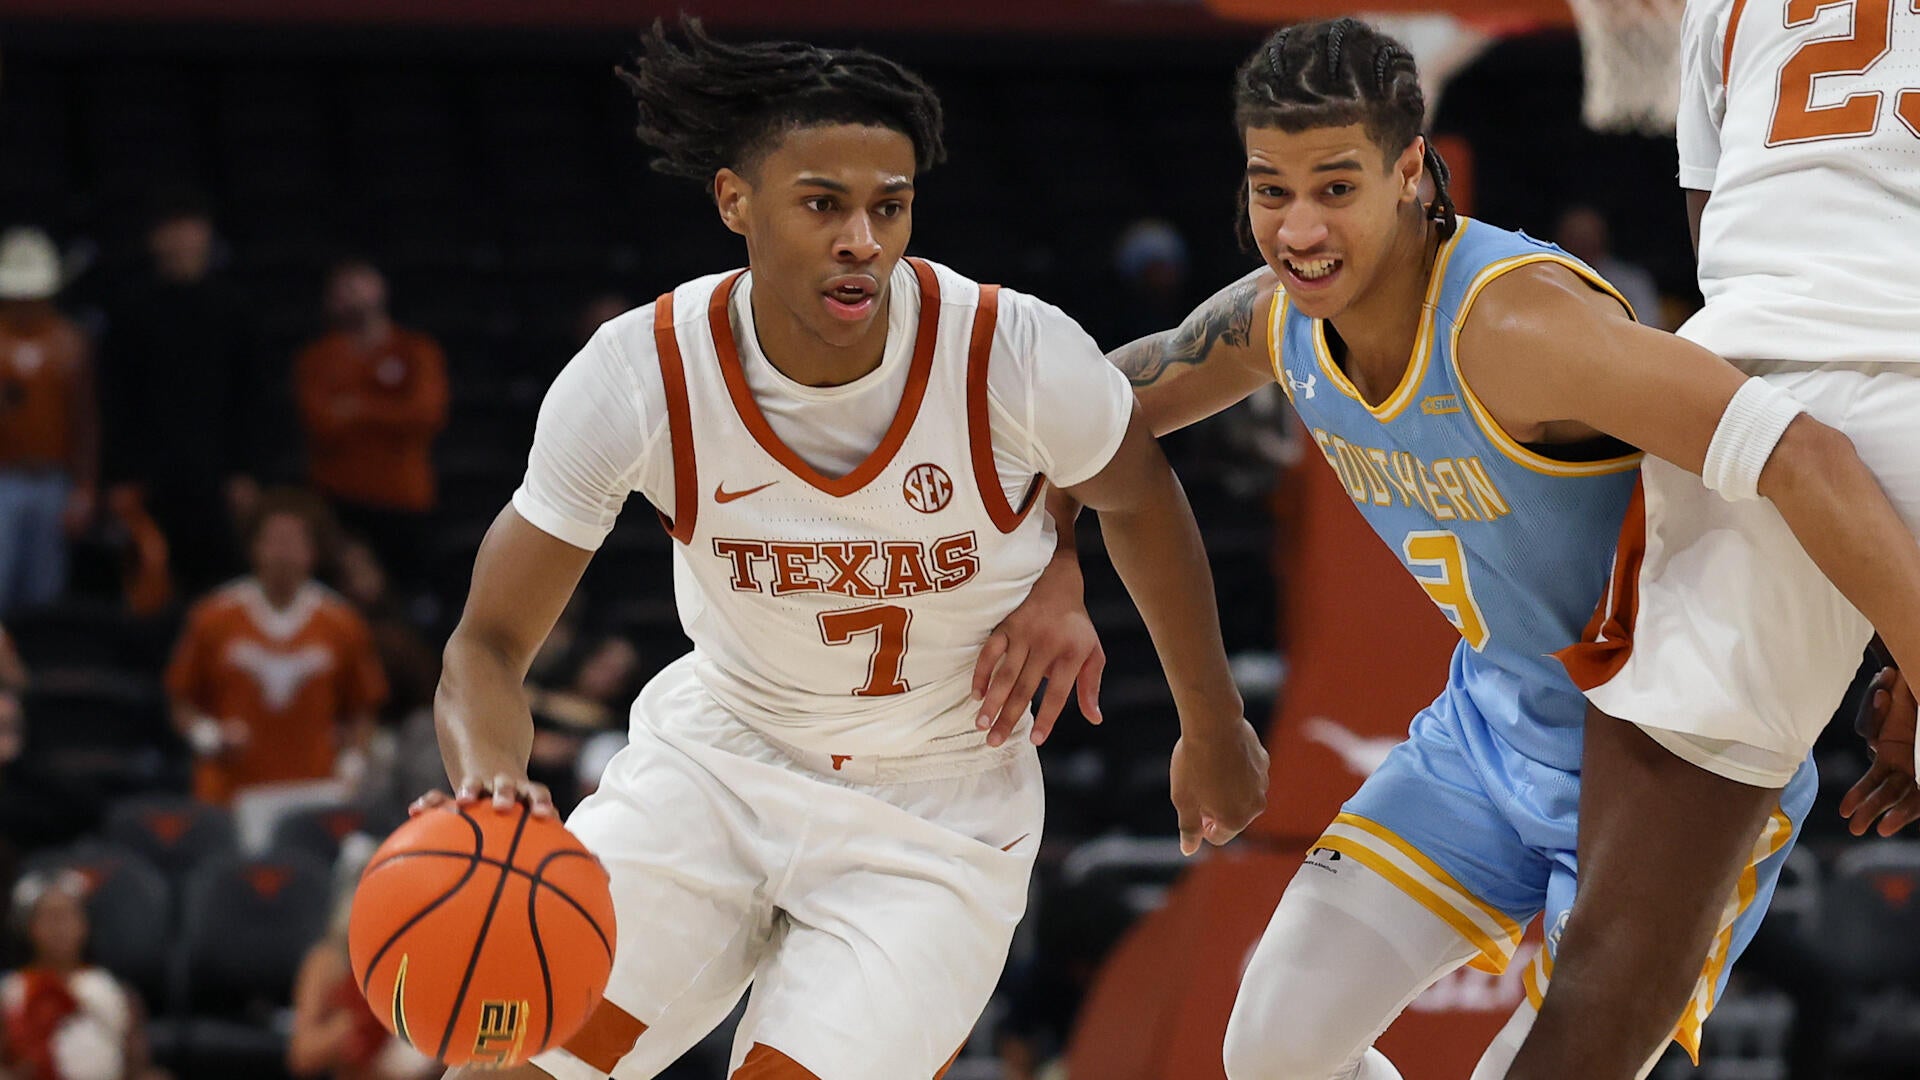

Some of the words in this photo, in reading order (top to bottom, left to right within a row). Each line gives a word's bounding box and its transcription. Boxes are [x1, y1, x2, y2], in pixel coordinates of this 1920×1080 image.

[1764, 0, 1920, 148] 2
[904, 464, 953, 514] SEC
[1313, 427, 1511, 521] SOUTHERN
[712, 530, 980, 600] TEXAS
[1402, 529, 1490, 653] 3
[817, 602, 913, 698] 7
